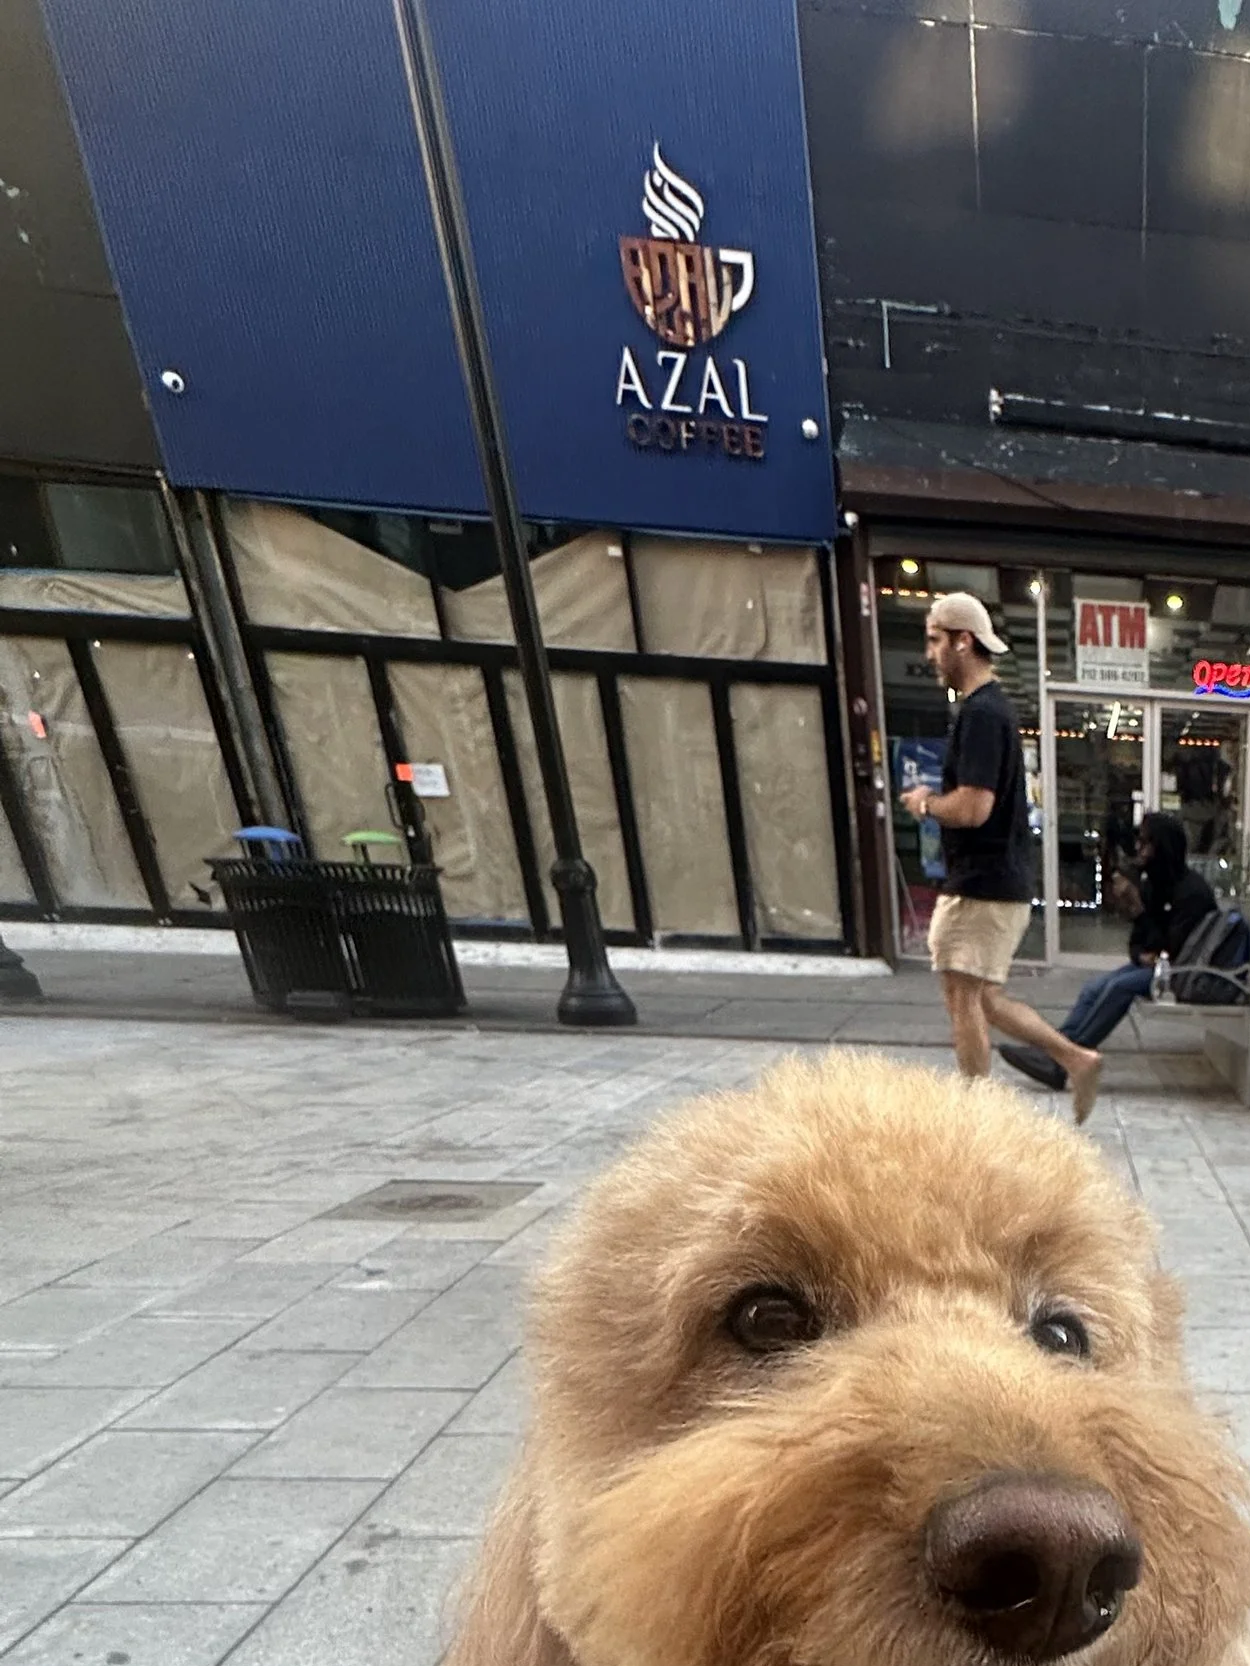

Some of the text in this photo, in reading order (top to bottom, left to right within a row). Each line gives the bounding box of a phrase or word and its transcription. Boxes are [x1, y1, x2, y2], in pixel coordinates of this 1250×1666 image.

[616, 345, 769, 422] AZAL
[627, 412, 765, 458] COFFEE
[1078, 602, 1147, 650] ATM
